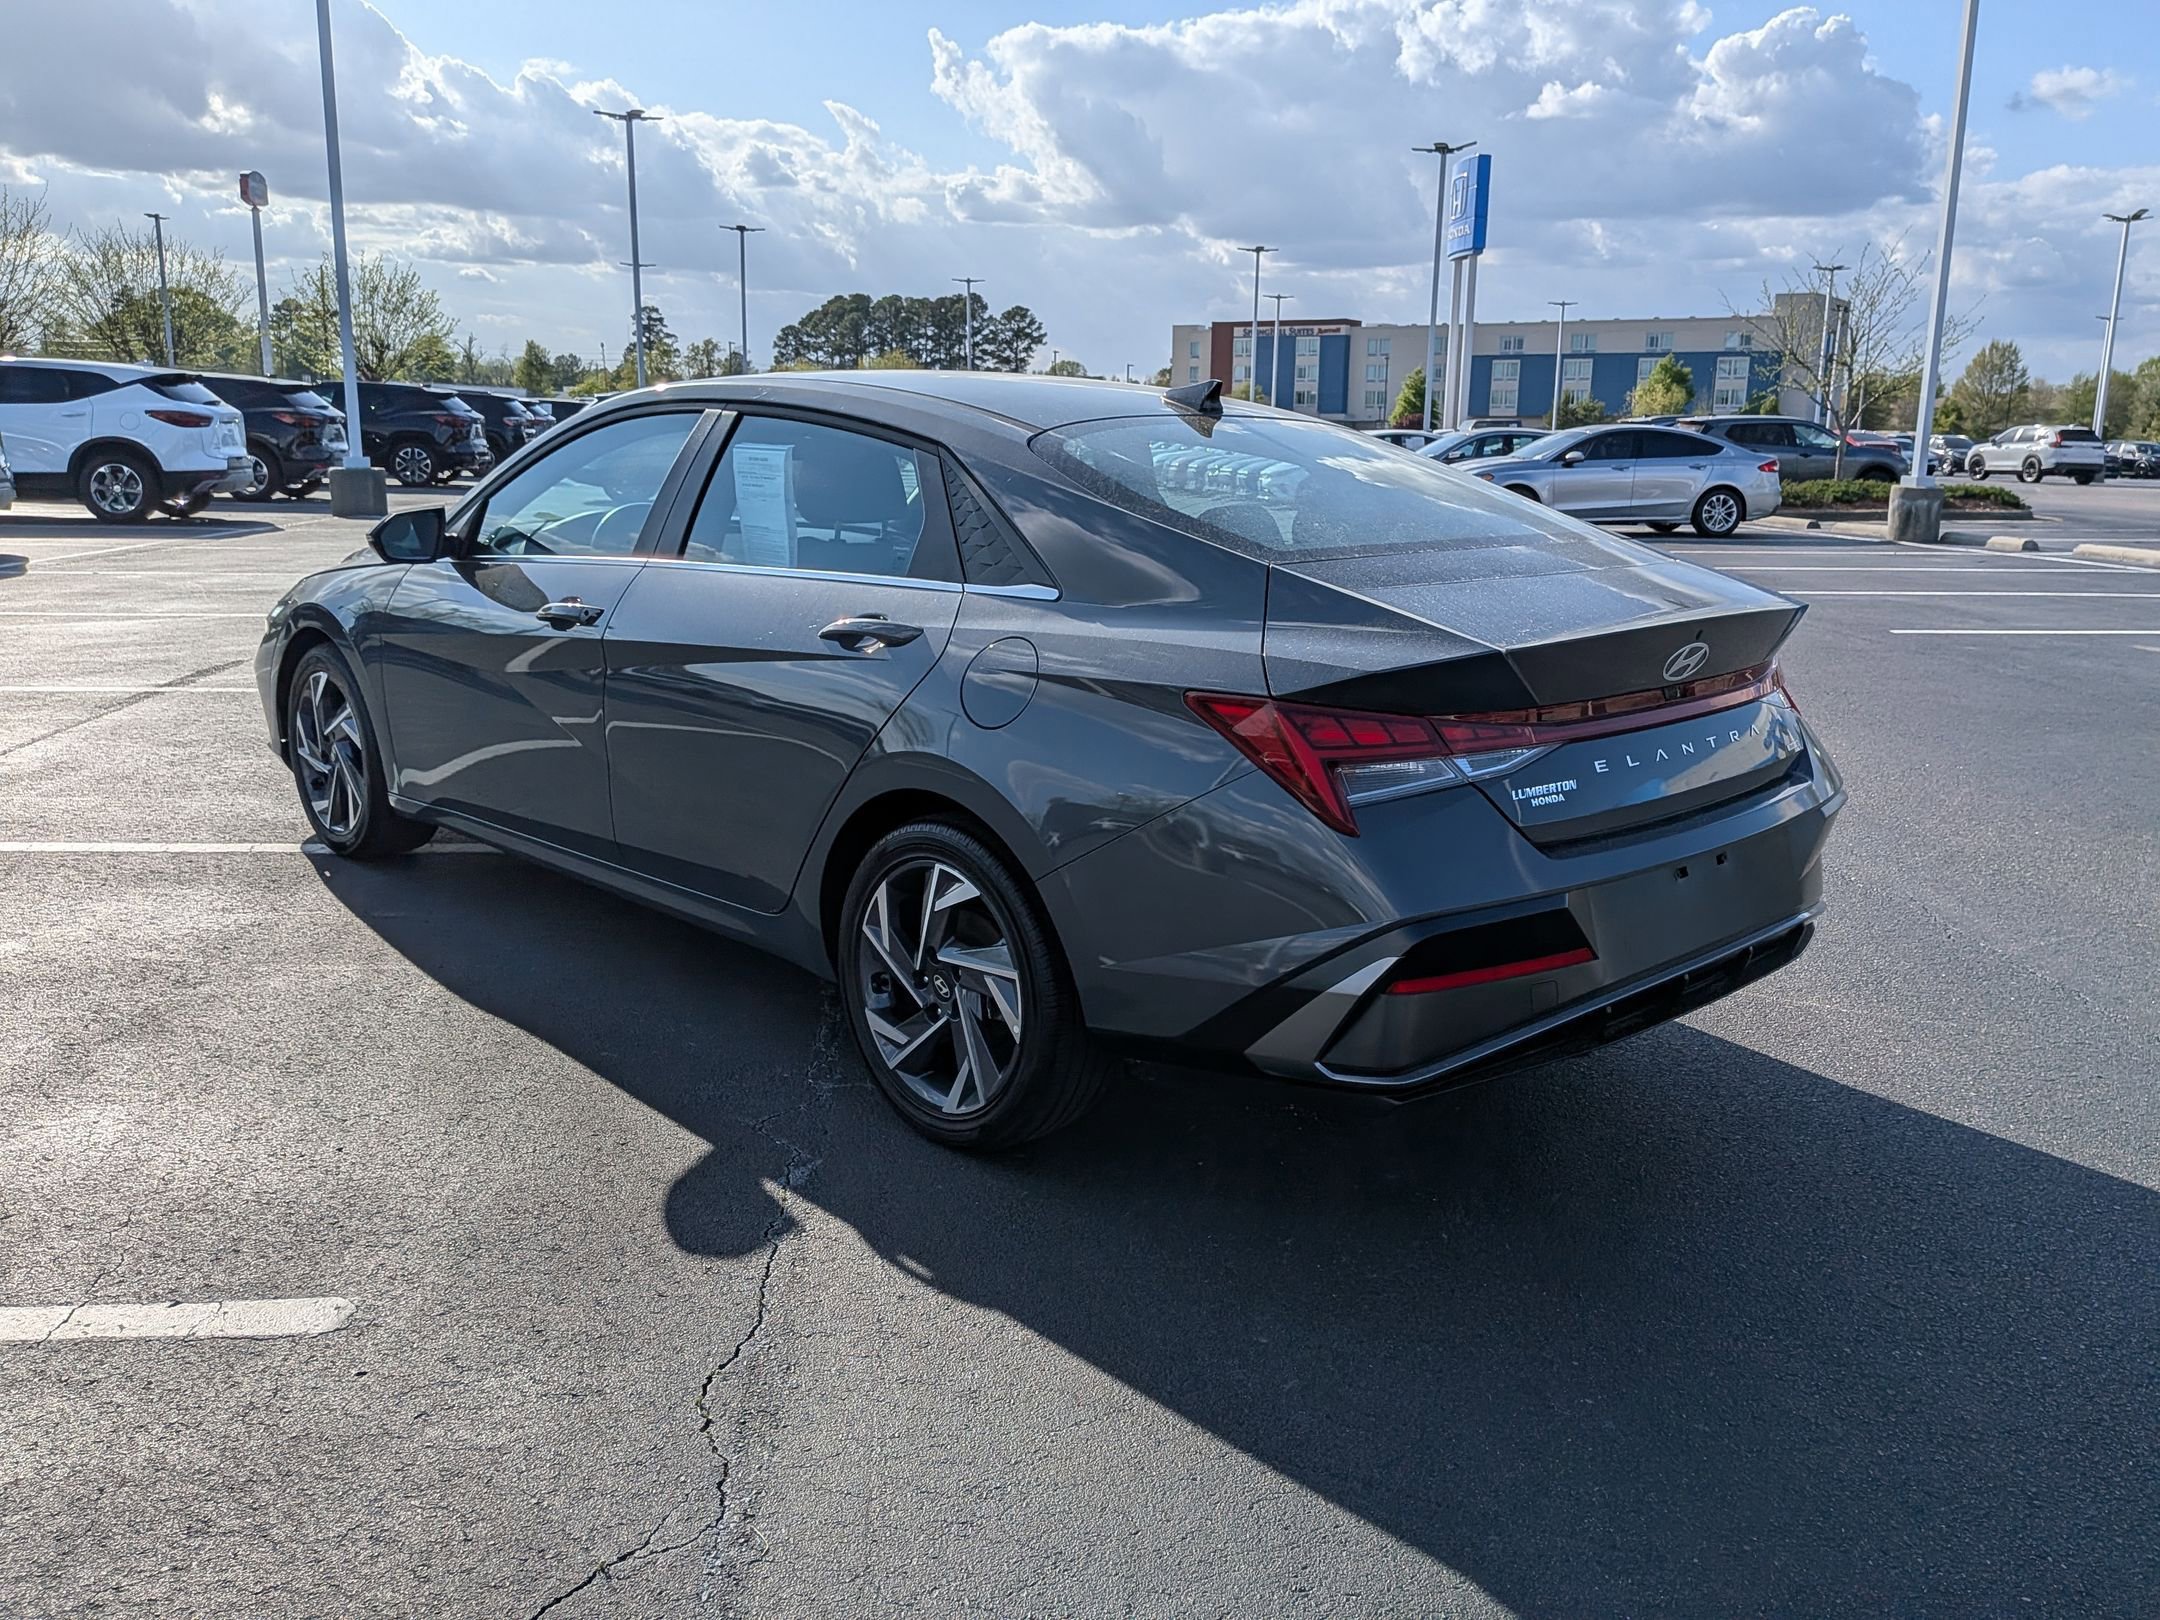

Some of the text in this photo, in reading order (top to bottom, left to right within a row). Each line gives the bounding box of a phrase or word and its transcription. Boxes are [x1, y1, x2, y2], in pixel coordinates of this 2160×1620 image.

[1594, 724, 1760, 774] ELANTRA
[1511, 779, 1577, 801] LUMBERTON
[1531, 793, 1565, 807] HONDA
